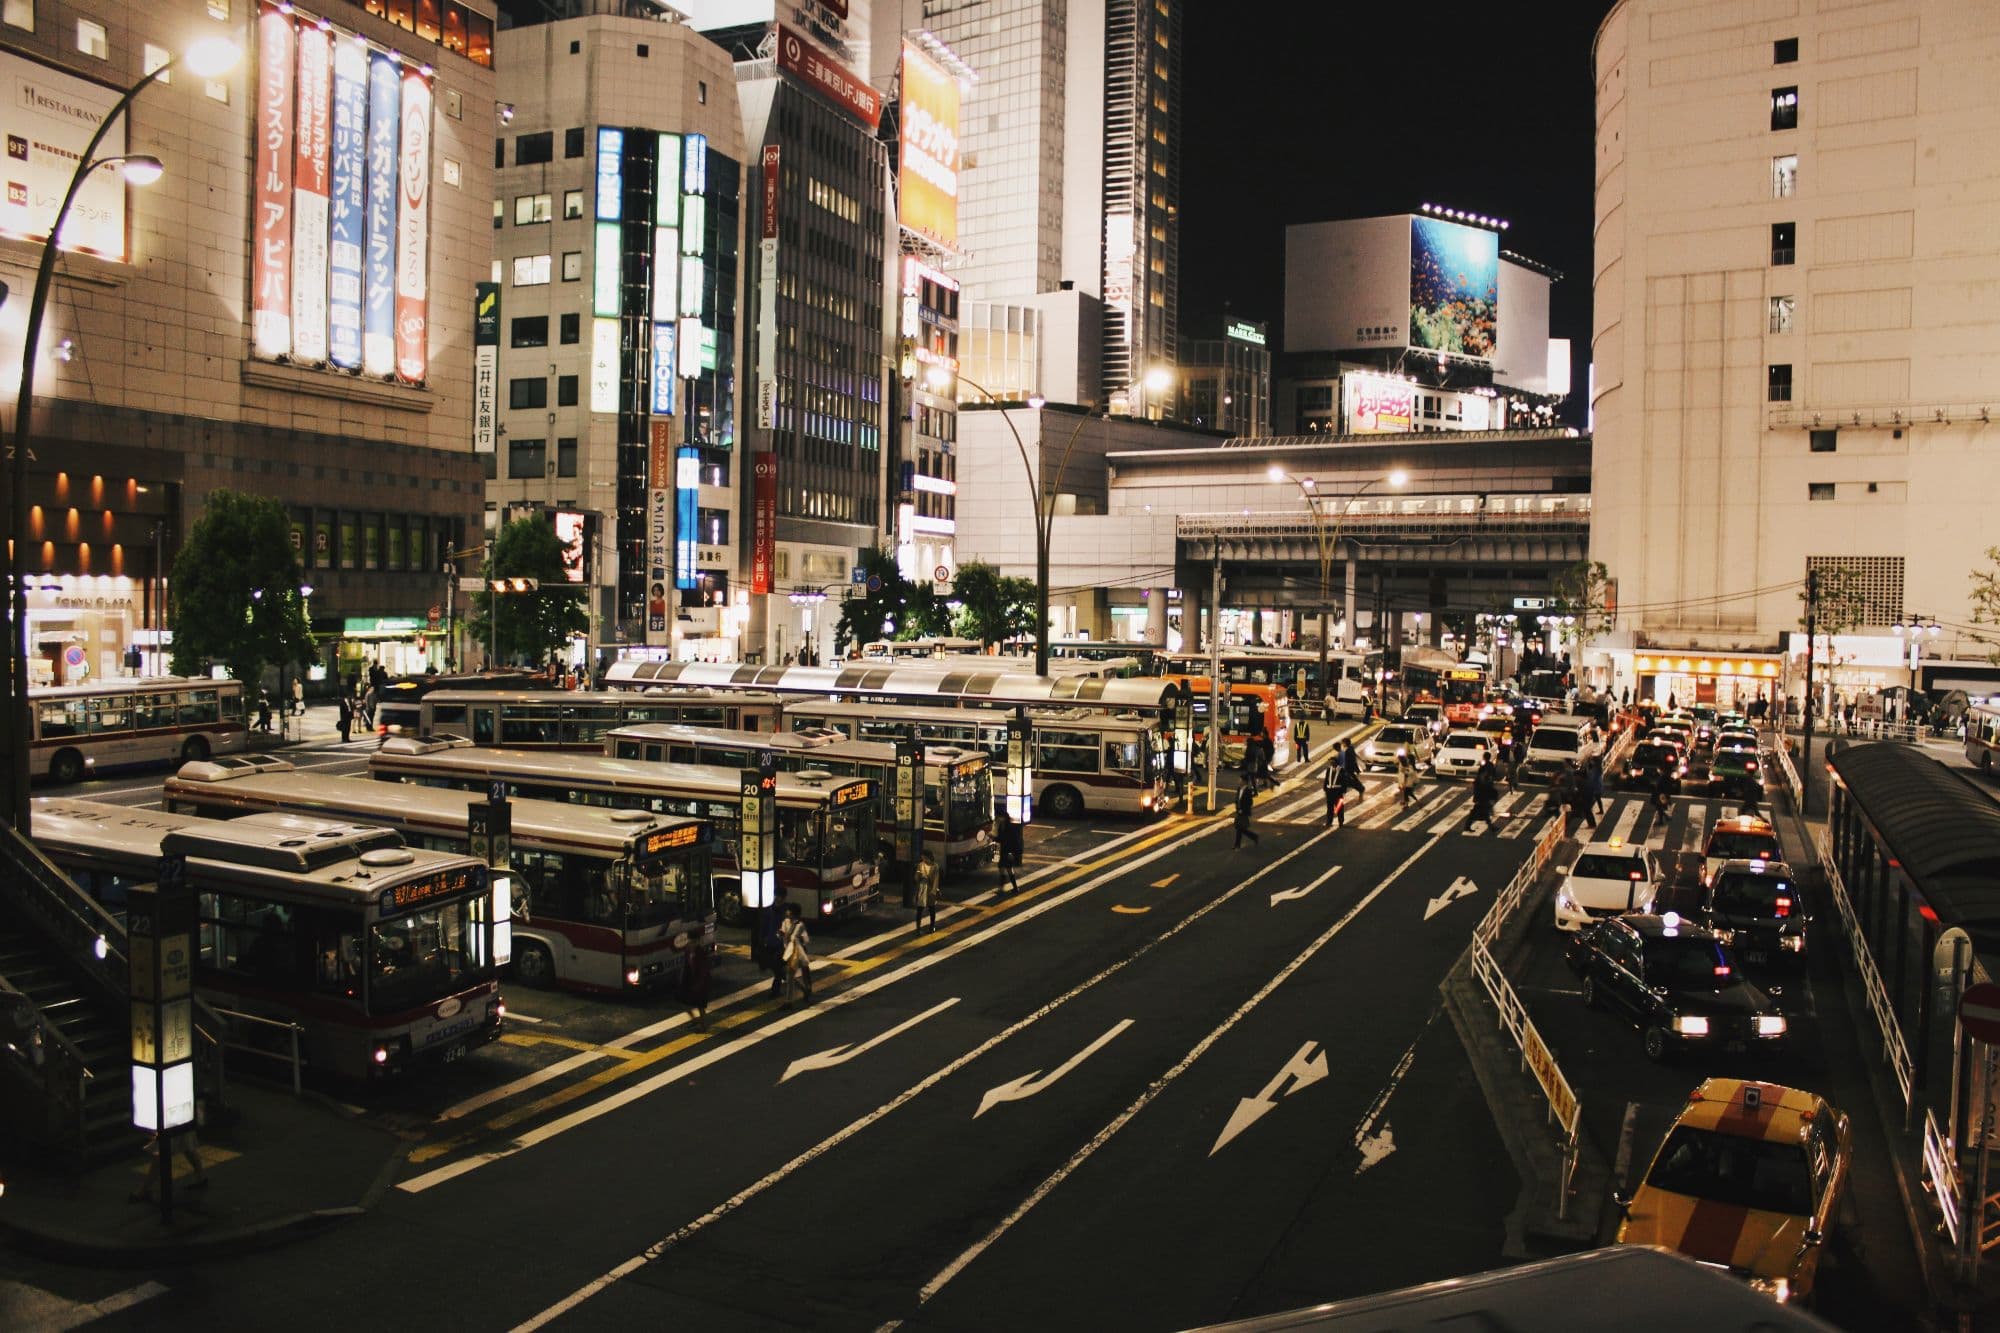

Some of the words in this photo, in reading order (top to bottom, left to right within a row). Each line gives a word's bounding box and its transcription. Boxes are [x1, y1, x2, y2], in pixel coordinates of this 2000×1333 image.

[807, 56, 874, 115] 三菱東京UFJ銀行
[9, 140, 26, 155] 9F
[9, 187, 27, 201] B2
[35, 191, 112, 224] レスラン街
[369, 117, 393, 312] メガネドラッグ
[261, 201, 286, 300] アビバ
[407, 218, 418, 288] DAISO
[479, 354, 492, 443] 三井住友銀行
[657, 423, 666, 488] コンタクトレンズの
[652, 505, 665, 565] メニコン渋谷
[651, 621, 664, 630] 9F
[1010, 730, 1021, 739] 18
[761, 752, 772, 766] 20
[898, 755, 911, 765] 19
[493, 782, 505, 799] 21
[744, 784, 758, 795] 20
[472, 820, 487, 834] 21
